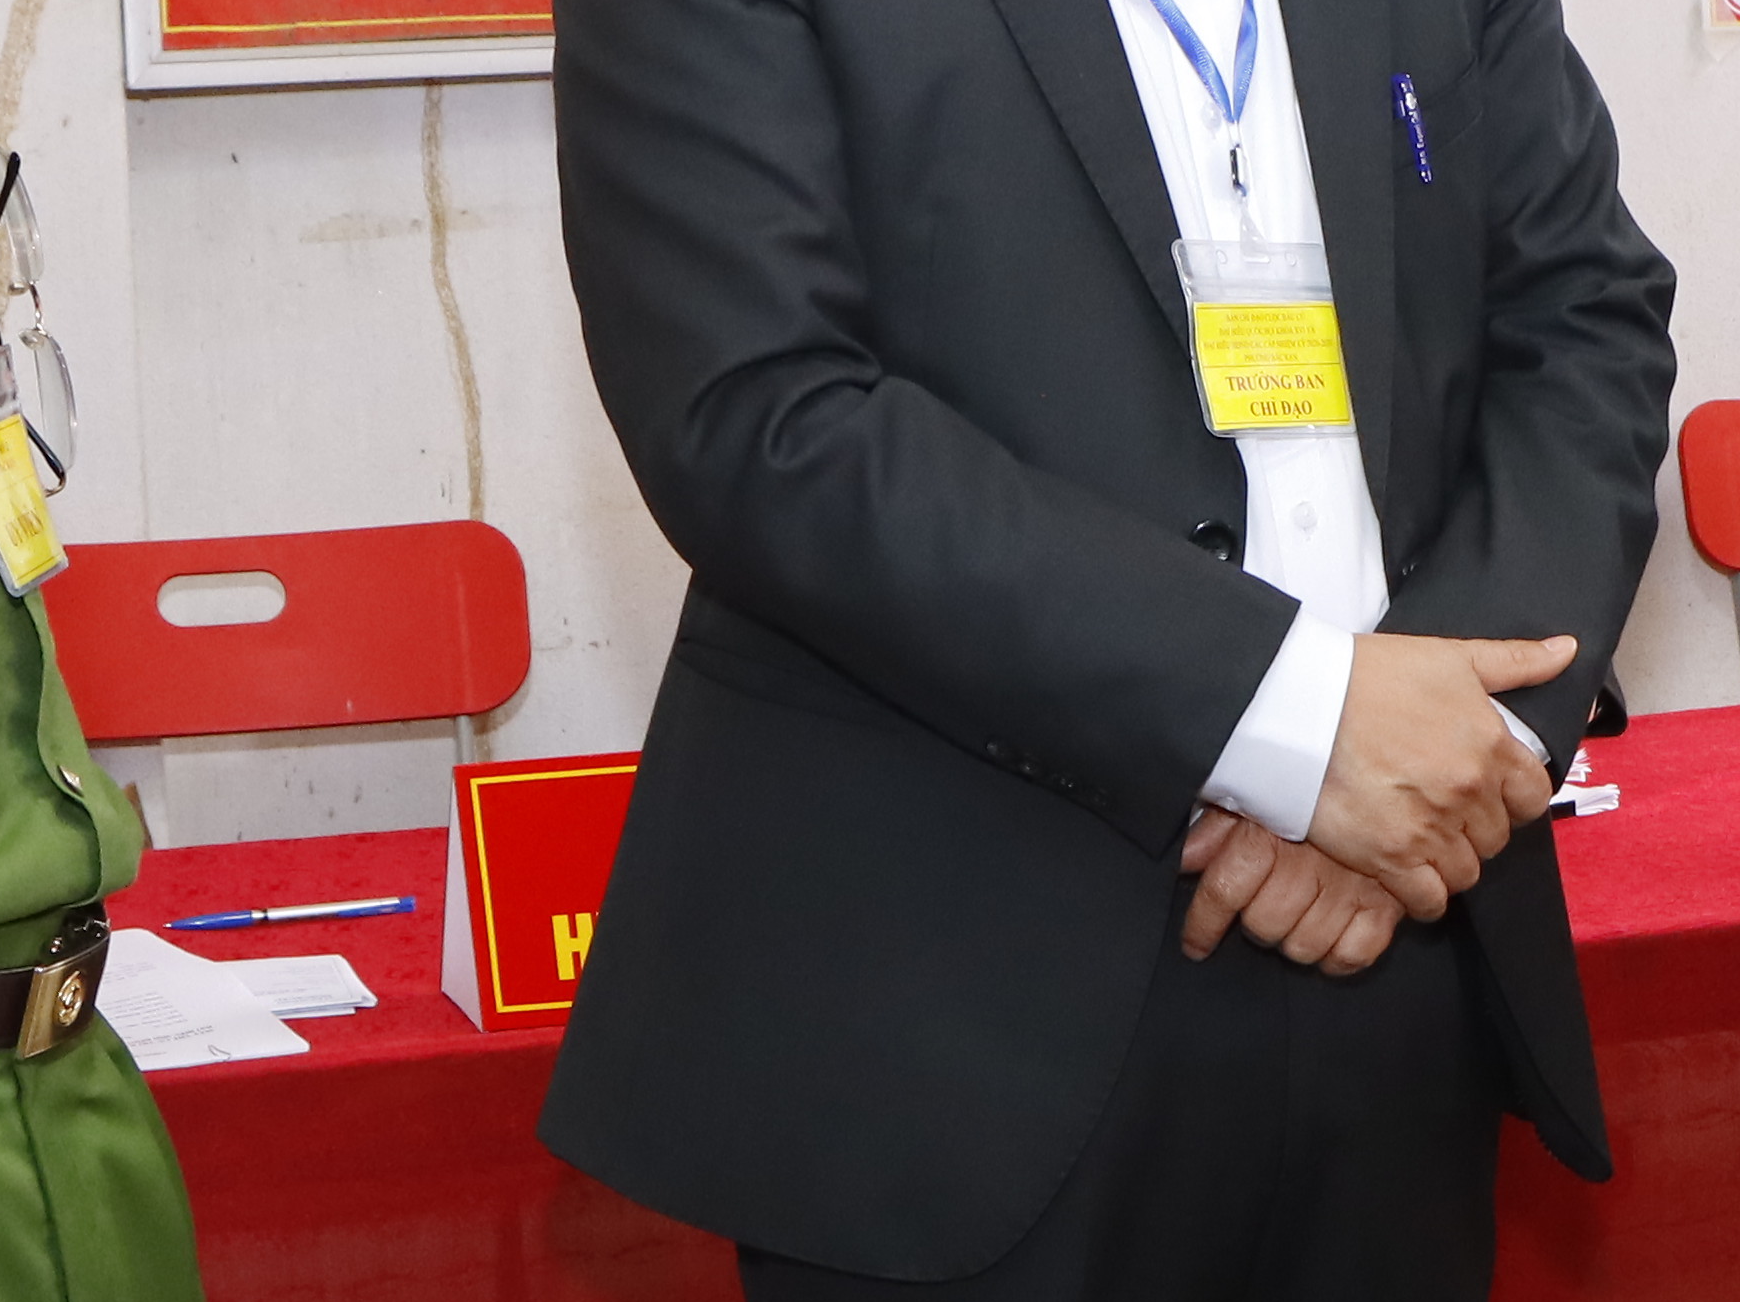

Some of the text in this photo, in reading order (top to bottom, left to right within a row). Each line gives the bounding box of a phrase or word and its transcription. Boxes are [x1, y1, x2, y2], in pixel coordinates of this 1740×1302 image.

[1226, 371, 1325, 391] TRƯỞNG BAN
[1250, 397, 1312, 419] CHỈ ĐẠO
